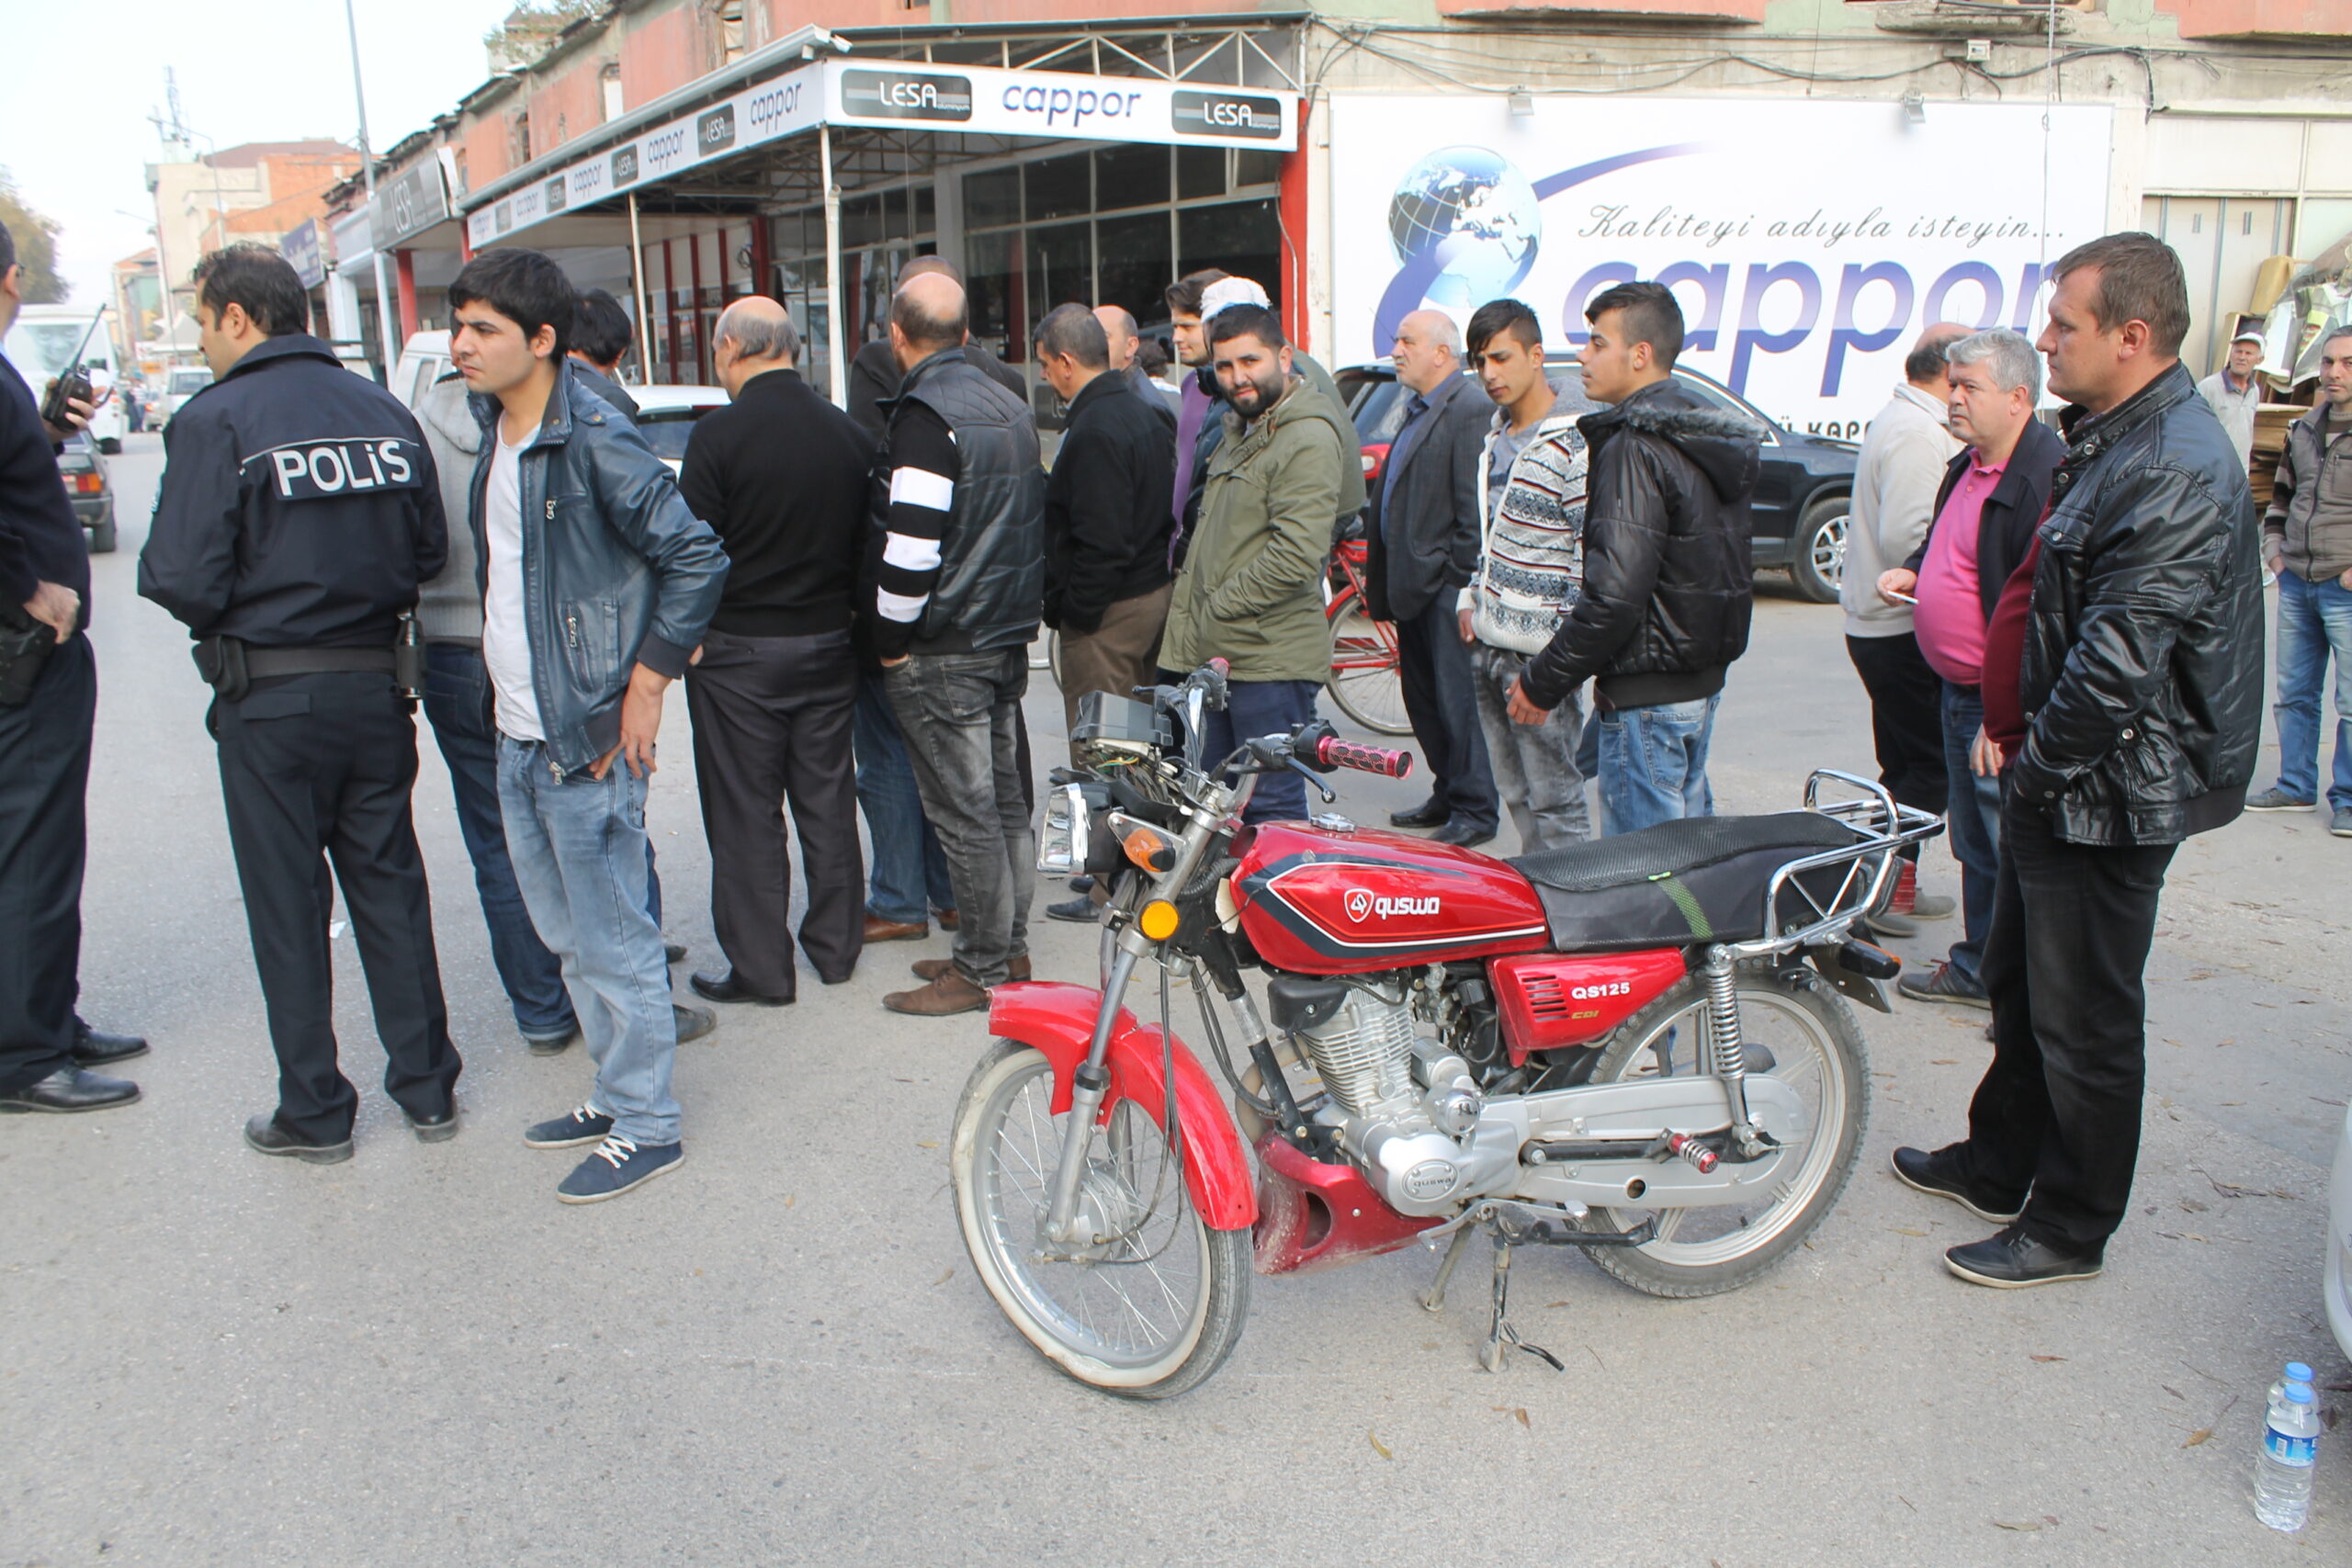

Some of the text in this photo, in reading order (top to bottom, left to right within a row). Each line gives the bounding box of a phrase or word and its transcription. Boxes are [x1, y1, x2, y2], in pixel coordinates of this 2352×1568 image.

[879, 81, 937, 107] LESA
[1002, 84, 1141, 127] cappor
[750, 82, 802, 134] cappor
[1204, 101, 1252, 127] LESA
[706, 116, 726, 143] LESA
[648, 128, 684, 171] cappor
[573, 164, 603, 198] cappor
[1578, 205, 2064, 249] Kaliteyi adıyla isteyin...
[1374, 897, 1441, 920] quswa
[1571, 982, 1631, 1000] QS125
[1571, 1010, 1600, 1021] CDI
